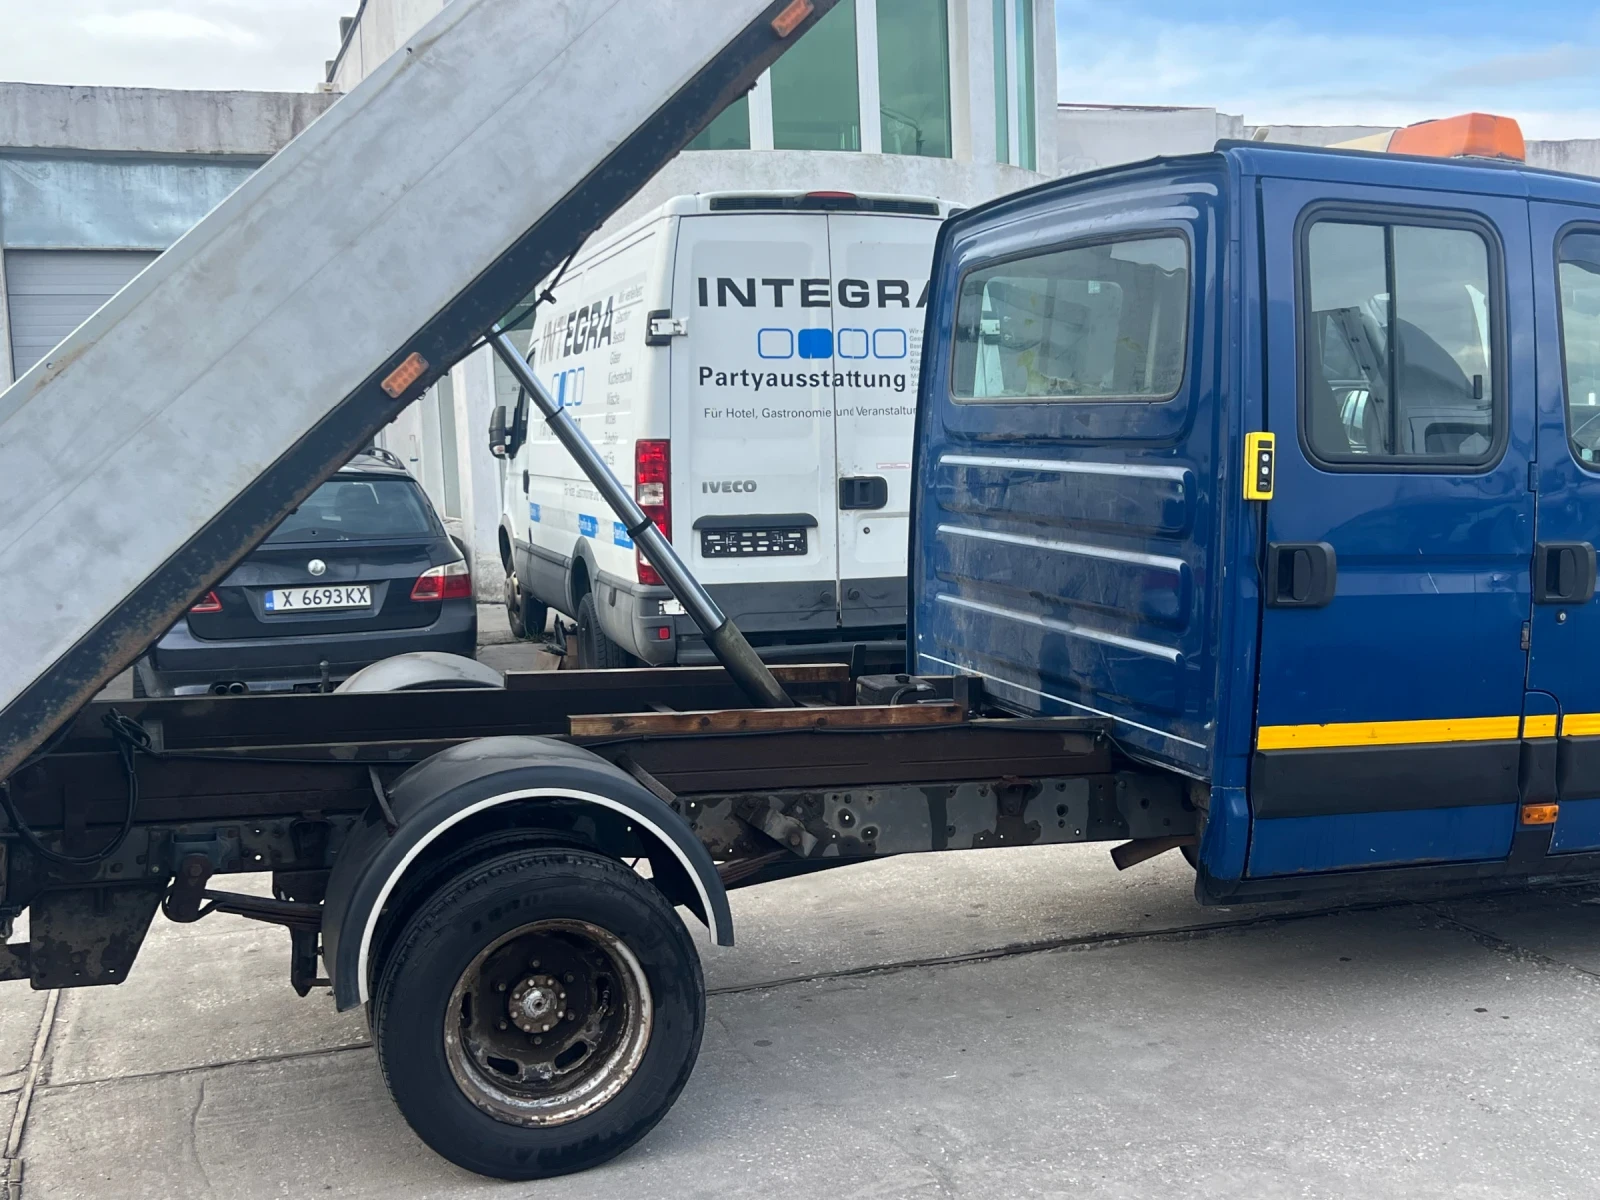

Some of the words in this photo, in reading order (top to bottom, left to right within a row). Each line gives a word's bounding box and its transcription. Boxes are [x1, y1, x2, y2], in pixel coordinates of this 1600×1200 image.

[699, 366, 906, 392] Partyausstattung
[704, 408, 722, 418] Für
[726, 408, 758, 419] Hotel,
[762, 408, 832, 418] Gastronomie
[702, 480, 757, 493] IVECO
[282, 591, 292, 607] X
